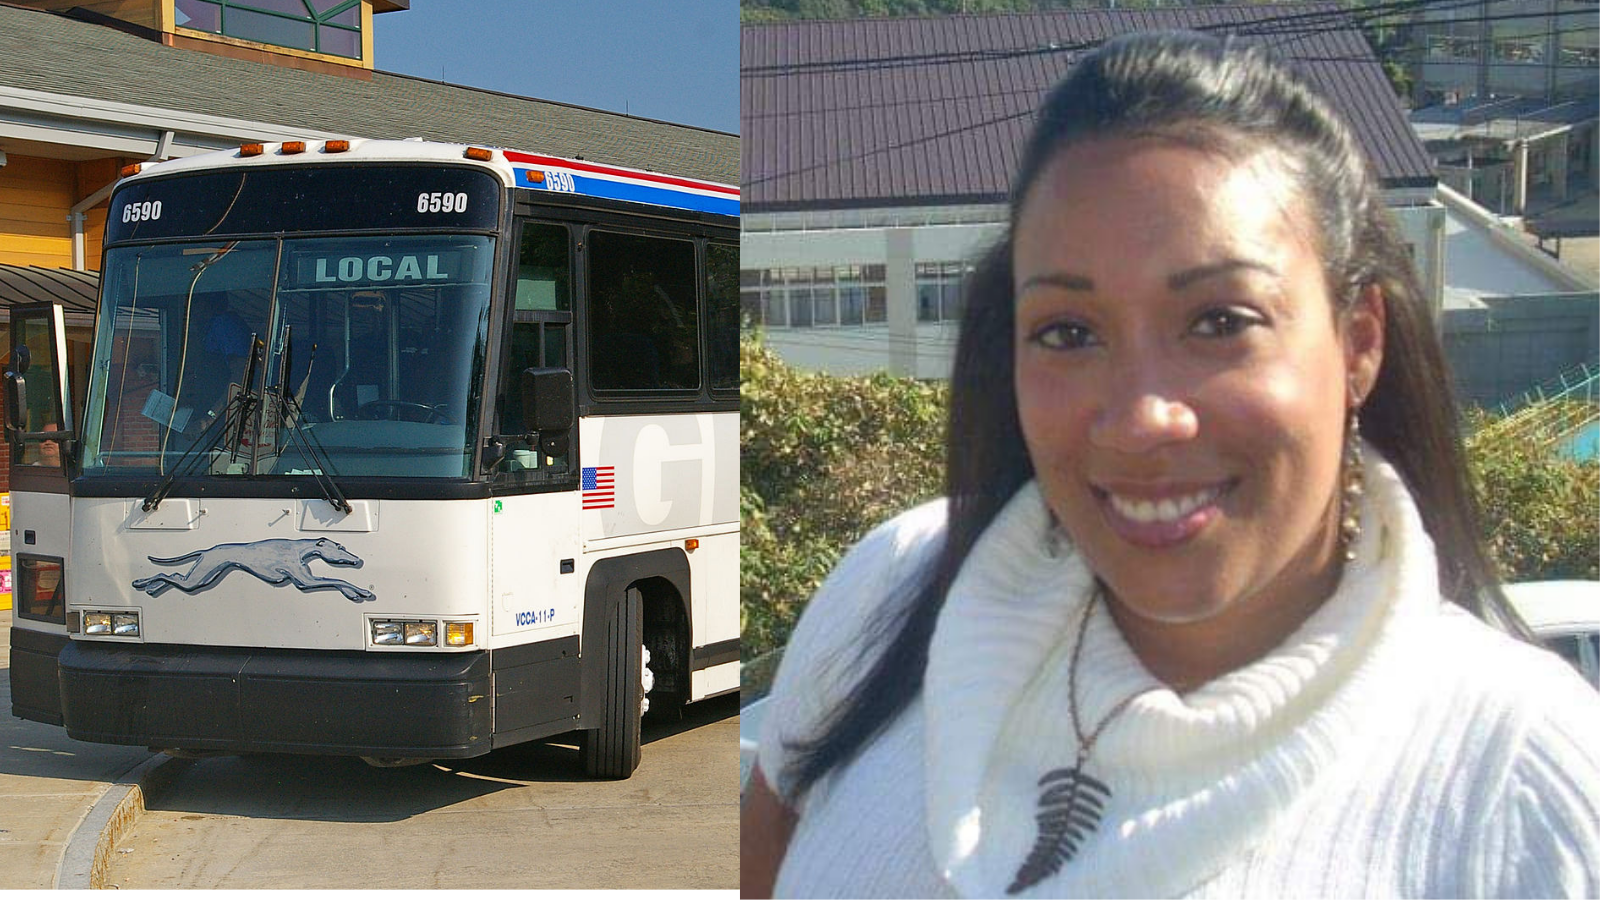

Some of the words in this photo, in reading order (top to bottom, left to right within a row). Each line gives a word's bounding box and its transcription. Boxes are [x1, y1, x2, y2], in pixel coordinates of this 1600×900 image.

[545, 171, 575, 192] 6590
[122, 200, 162, 223] 6590
[416, 192, 468, 213] 6590
[315, 254, 448, 283] LOCAL
[515, 608, 555, 626] VCCA-11-P
